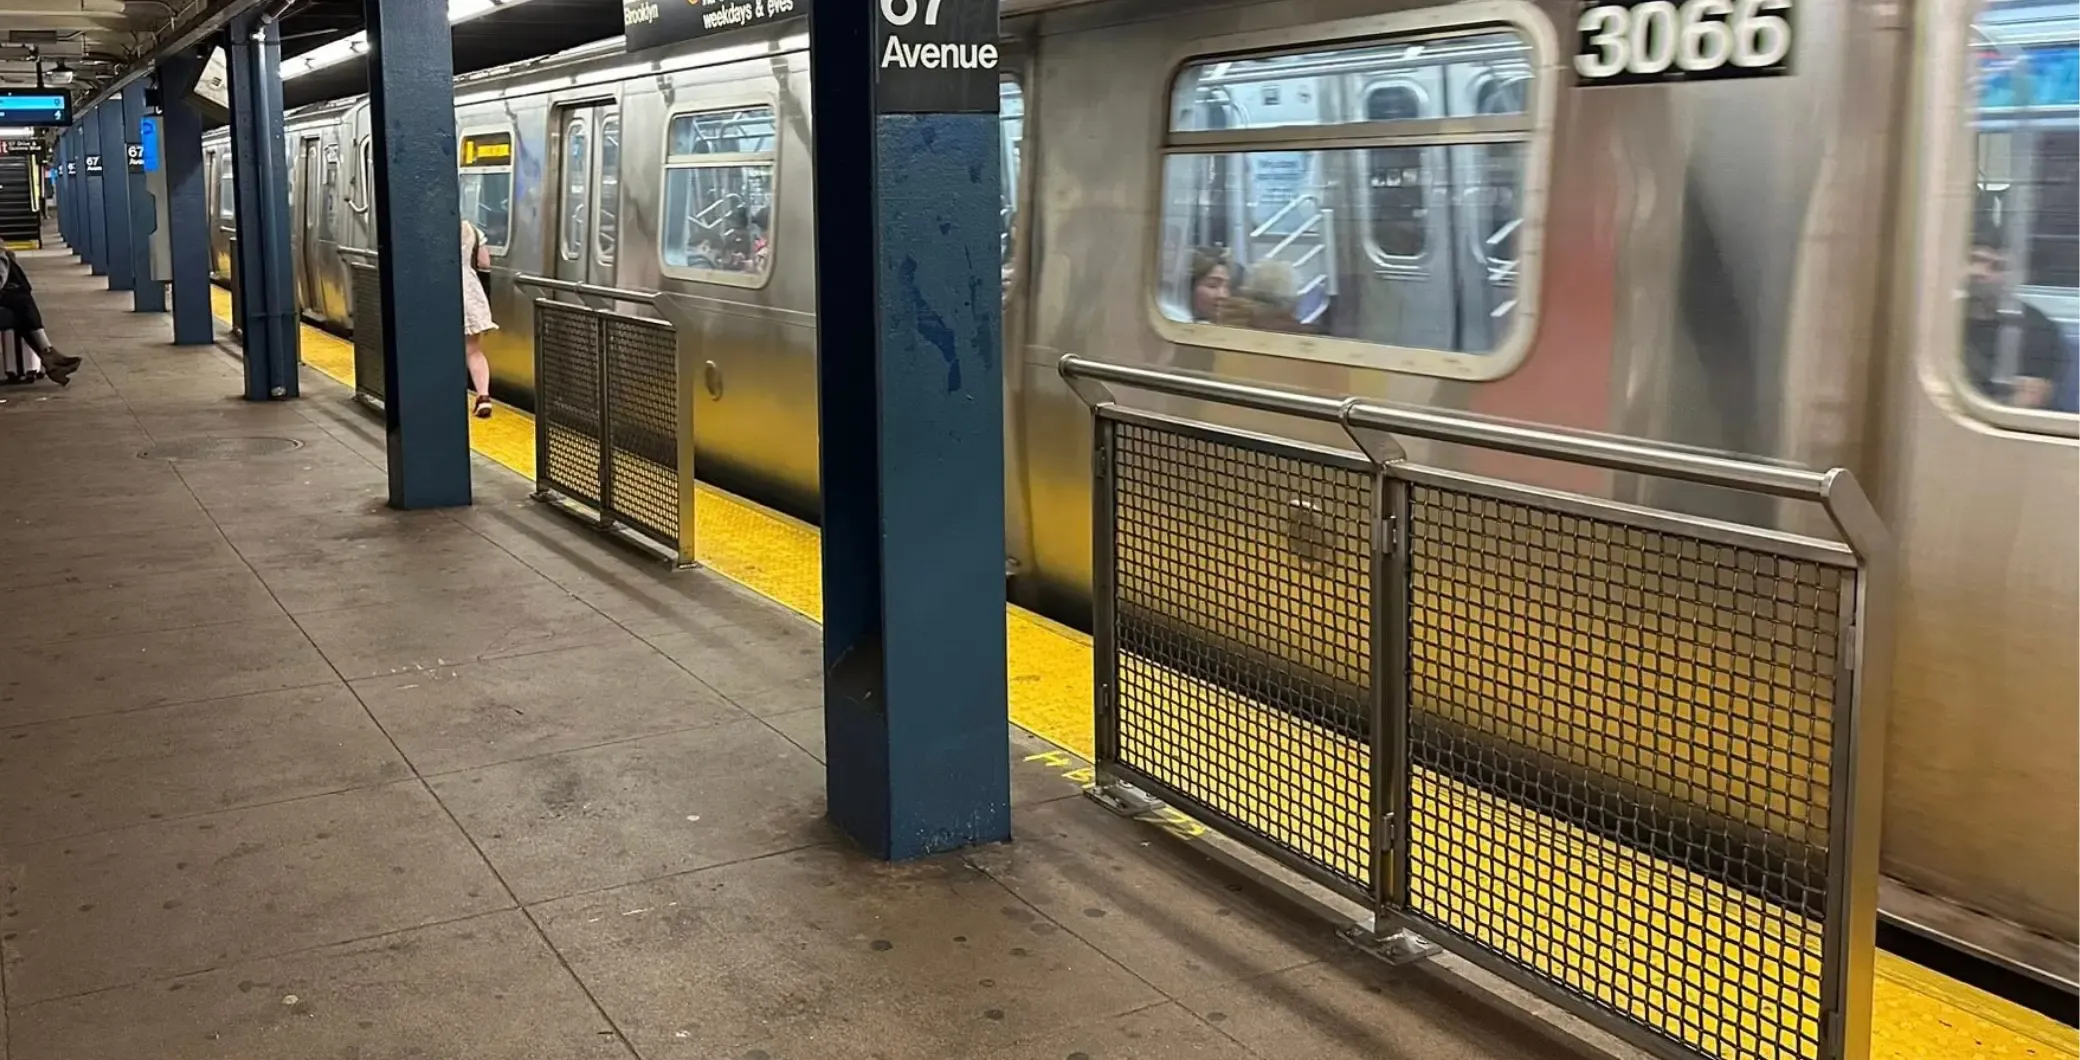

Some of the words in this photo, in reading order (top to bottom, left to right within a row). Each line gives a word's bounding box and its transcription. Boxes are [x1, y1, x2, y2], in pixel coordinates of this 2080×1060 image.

[702, 2, 753, 29] weekdays
[755, 0, 765, 18] &
[881, 35, 999, 69] Avenue
[1573, 0, 1792, 78] 3066
[85, 155, 101, 166] 67
[127, 146, 145, 158] 67
